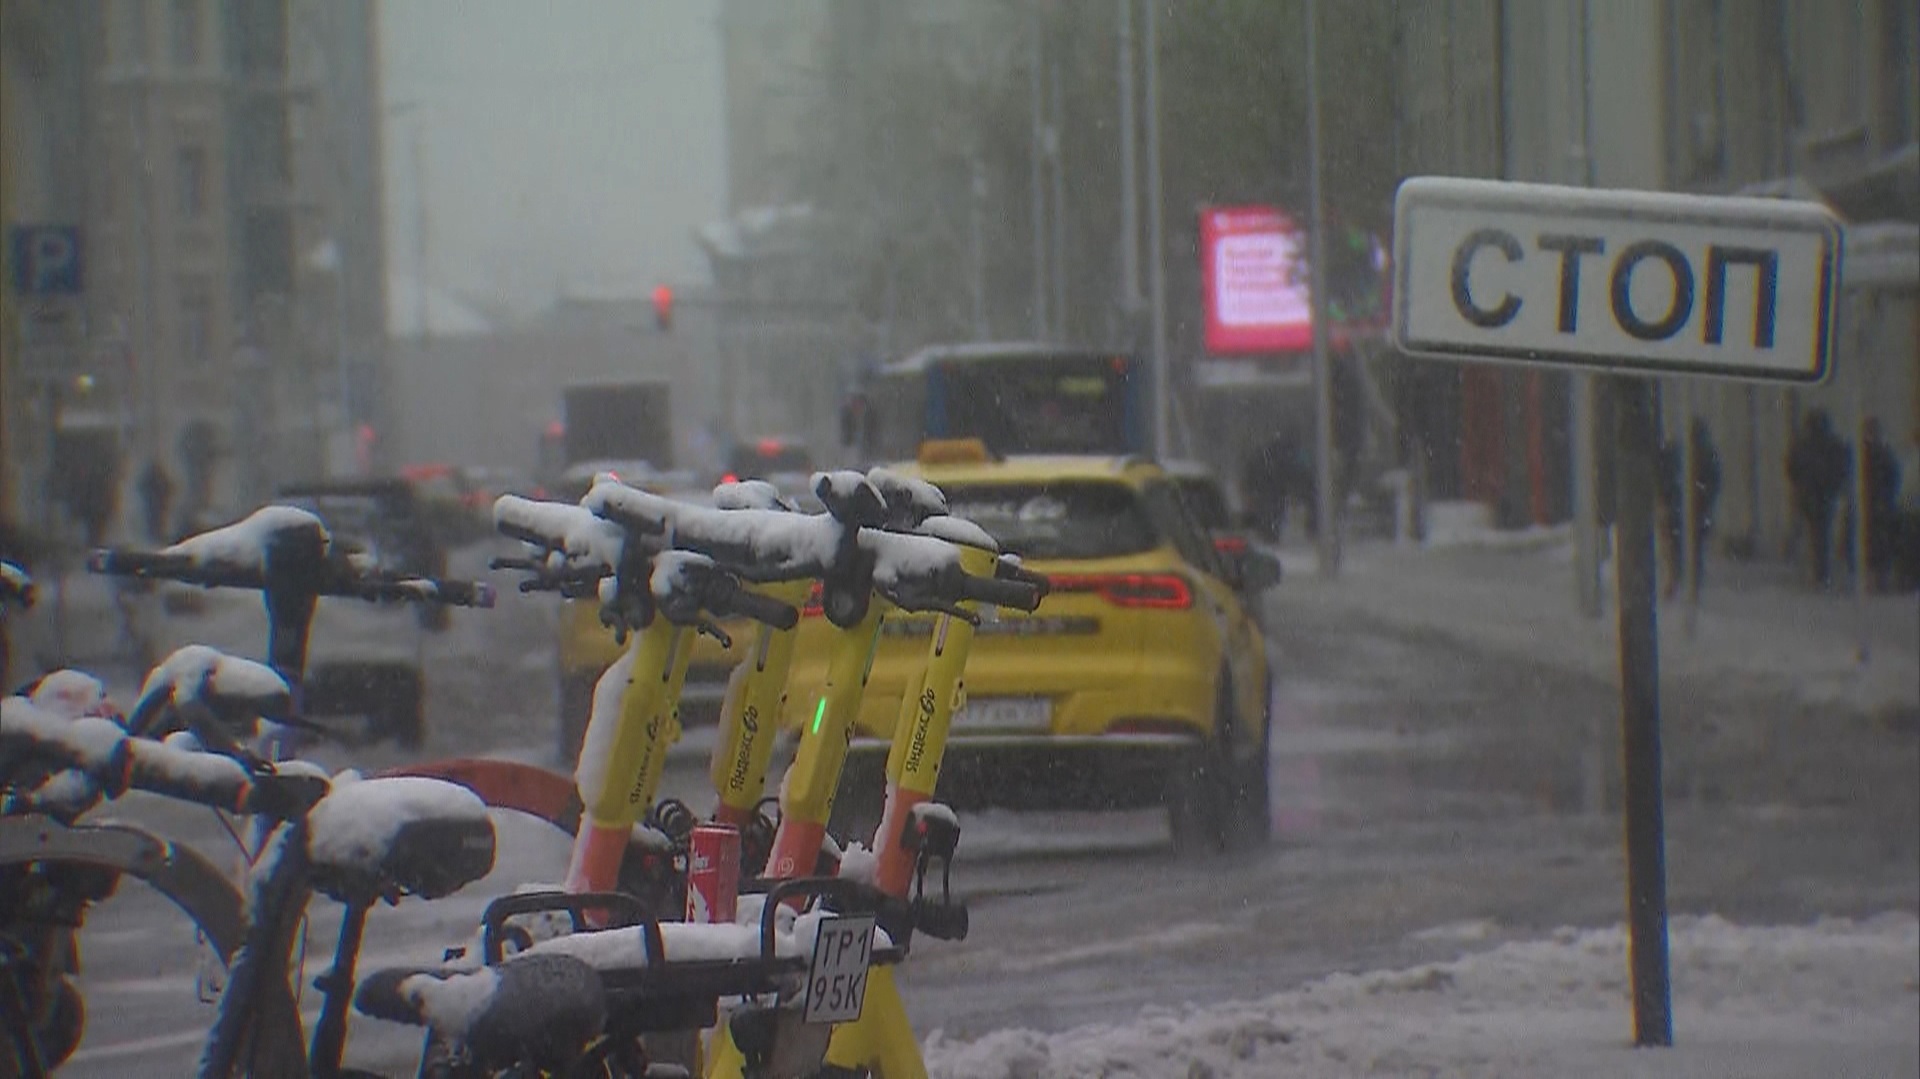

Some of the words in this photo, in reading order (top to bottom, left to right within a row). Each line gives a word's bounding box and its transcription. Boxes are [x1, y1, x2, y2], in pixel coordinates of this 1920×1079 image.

[29, 234, 70, 291] P
[1450, 228, 1778, 349] СТОП
[730, 733, 755, 791] Яндекс
[744, 705, 758, 733] Go
[906, 714, 930, 773] Яндекс
[920, 688, 935, 714] Go
